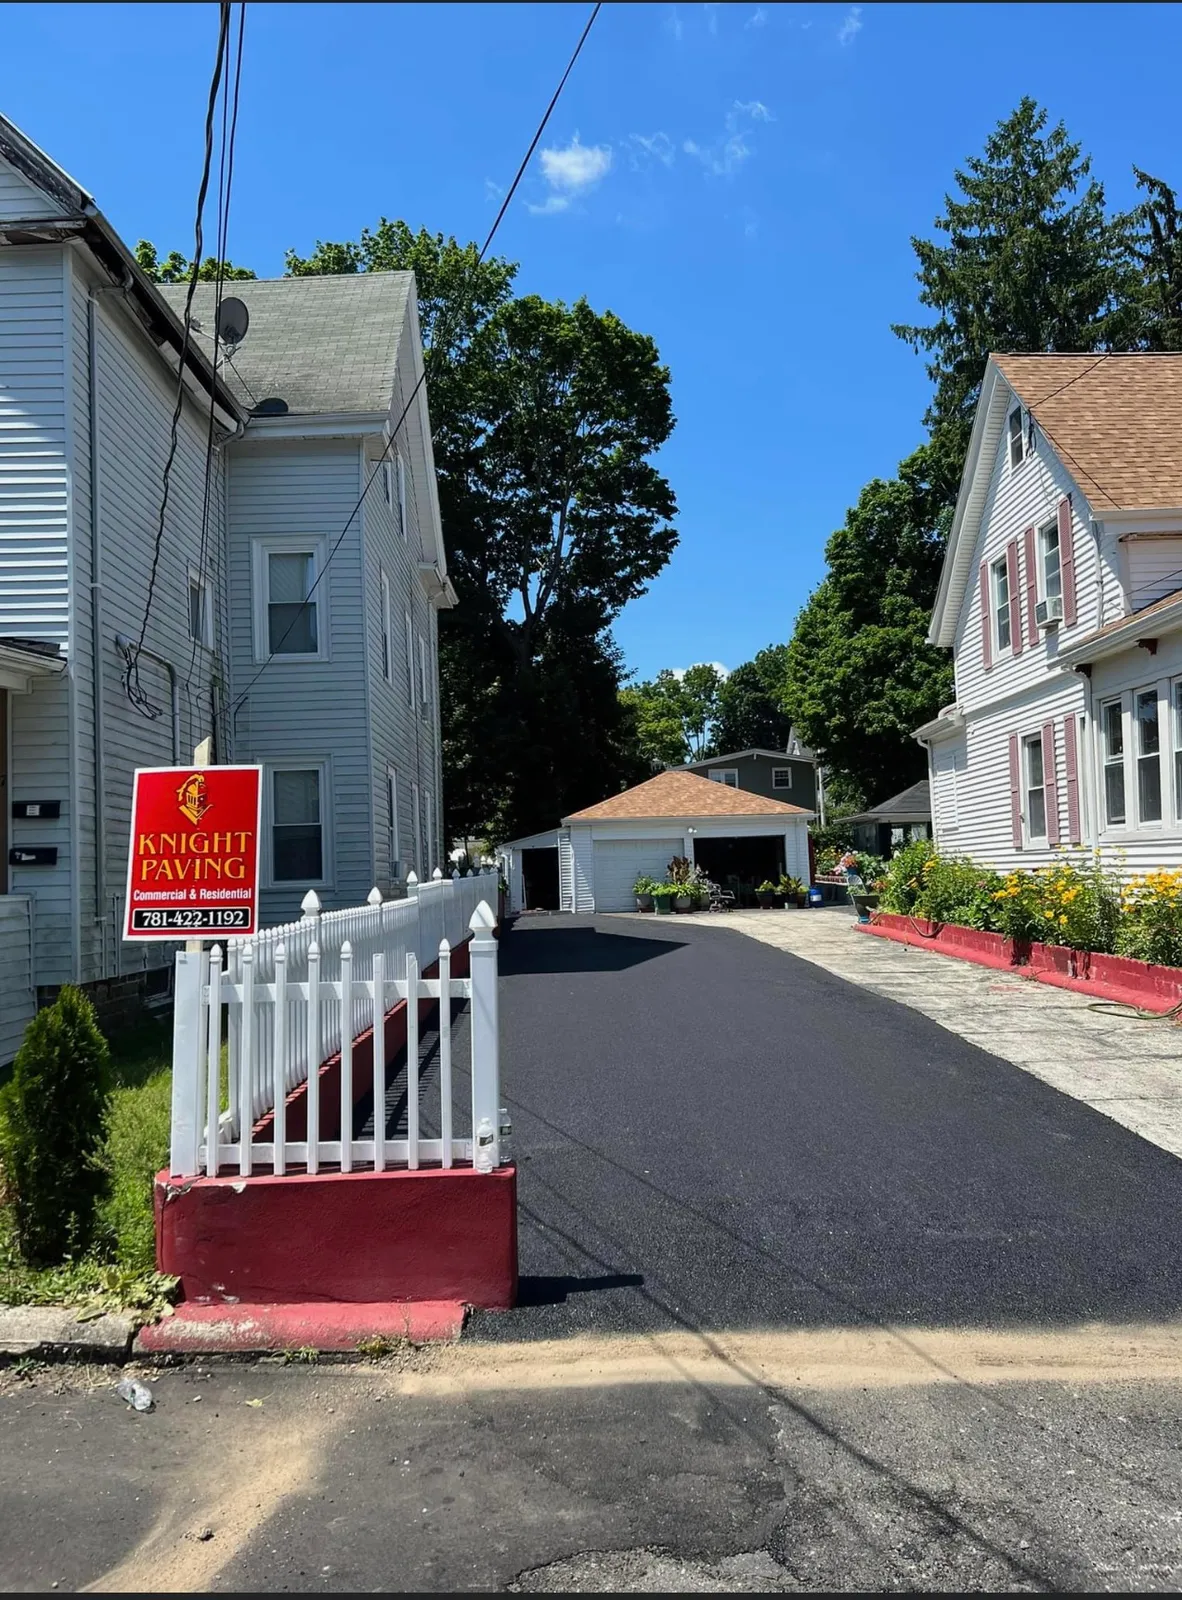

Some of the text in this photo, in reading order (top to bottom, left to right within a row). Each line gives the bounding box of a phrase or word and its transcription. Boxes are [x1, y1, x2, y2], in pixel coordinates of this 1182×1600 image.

[138, 832, 253, 855] KNIGHT
[141, 857, 245, 881] PAVING
[133, 887, 252, 901] Commercial & Residential
[142, 910, 244, 927] 781-422-1192
